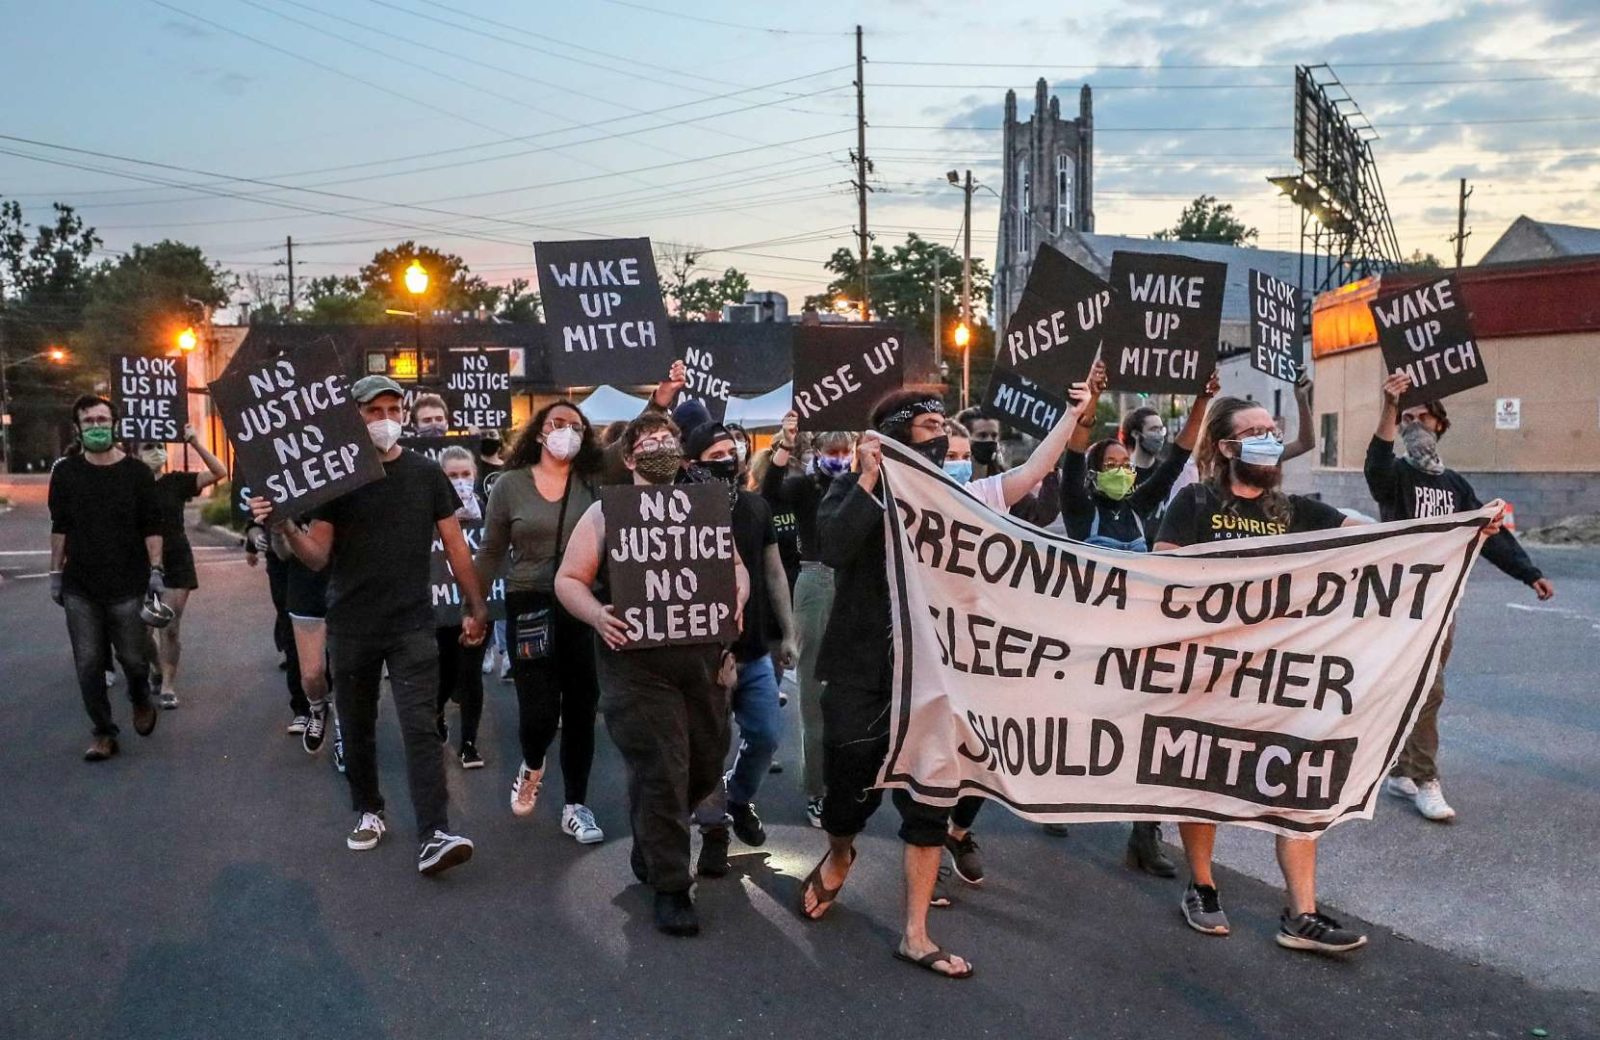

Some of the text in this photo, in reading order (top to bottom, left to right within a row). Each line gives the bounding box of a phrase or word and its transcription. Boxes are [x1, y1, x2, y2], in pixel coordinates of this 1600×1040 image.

[549, 258, 640, 287] WAKE
[1256, 271, 1295, 308] LOOK
[579, 292, 621, 318] UP
[1129, 272, 1204, 309] WAKE
[1375, 279, 1456, 329] WAKE
[1008, 290, 1110, 367] RISE UP
[1145, 311, 1181, 340] UP
[1257, 295, 1295, 331] US IN
[563, 321, 656, 352] MITCH
[1257, 321, 1291, 355] THE
[1405, 320, 1441, 352] UP
[122, 356, 176, 377] LOOK
[463, 355, 489, 371] NO
[685, 346, 713, 371] NO
[1119, 347, 1199, 380] MITCH
[1257, 344, 1297, 382] EYES
[1395, 341, 1477, 388] MITCH
[122, 376, 177, 396] US IN
[248, 360, 295, 398] NO
[447, 373, 509, 390] JUSTICE
[685, 368, 731, 401] STICE
[794, 337, 899, 419] RISE UP
[122, 397, 170, 417] THE
[238, 375, 346, 442] JUSTICE
[464, 393, 491, 409] NO
[993, 383, 1057, 431] MITCH
[121, 417, 177, 439] EYES
[453, 410, 507, 427] SLEEP
[273, 424, 324, 465] NO
[266, 443, 360, 503] SLEEP
[639, 489, 692, 523] NO
[1212, 514, 1286, 535] SUNRISE
[611, 525, 732, 563] JUSTICE
[431, 579, 505, 606] MIH
[645, 567, 697, 602] NO
[1160, 562, 1445, 625] COULD'NT
[625, 603, 729, 641] SLEEP
[1094, 642, 1354, 715] NEITHER
[958, 709, 1336, 798] SHOULD MITCH
